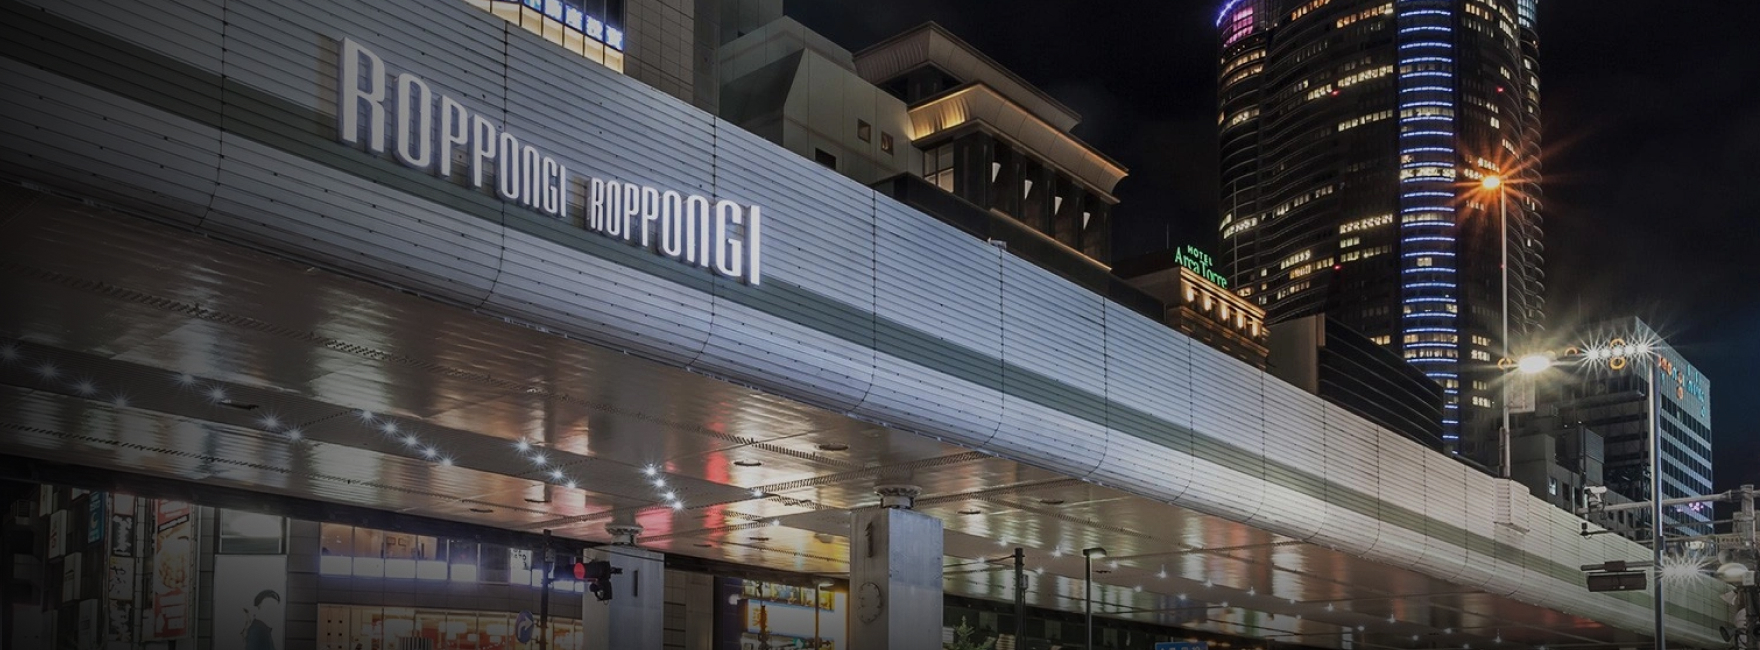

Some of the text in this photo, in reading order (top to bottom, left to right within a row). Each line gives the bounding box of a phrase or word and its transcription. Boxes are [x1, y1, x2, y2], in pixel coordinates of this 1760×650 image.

[340, 37, 761, 286] ROPPONGI ROPPONGI
[1187, 244, 1213, 267] HOTEL
